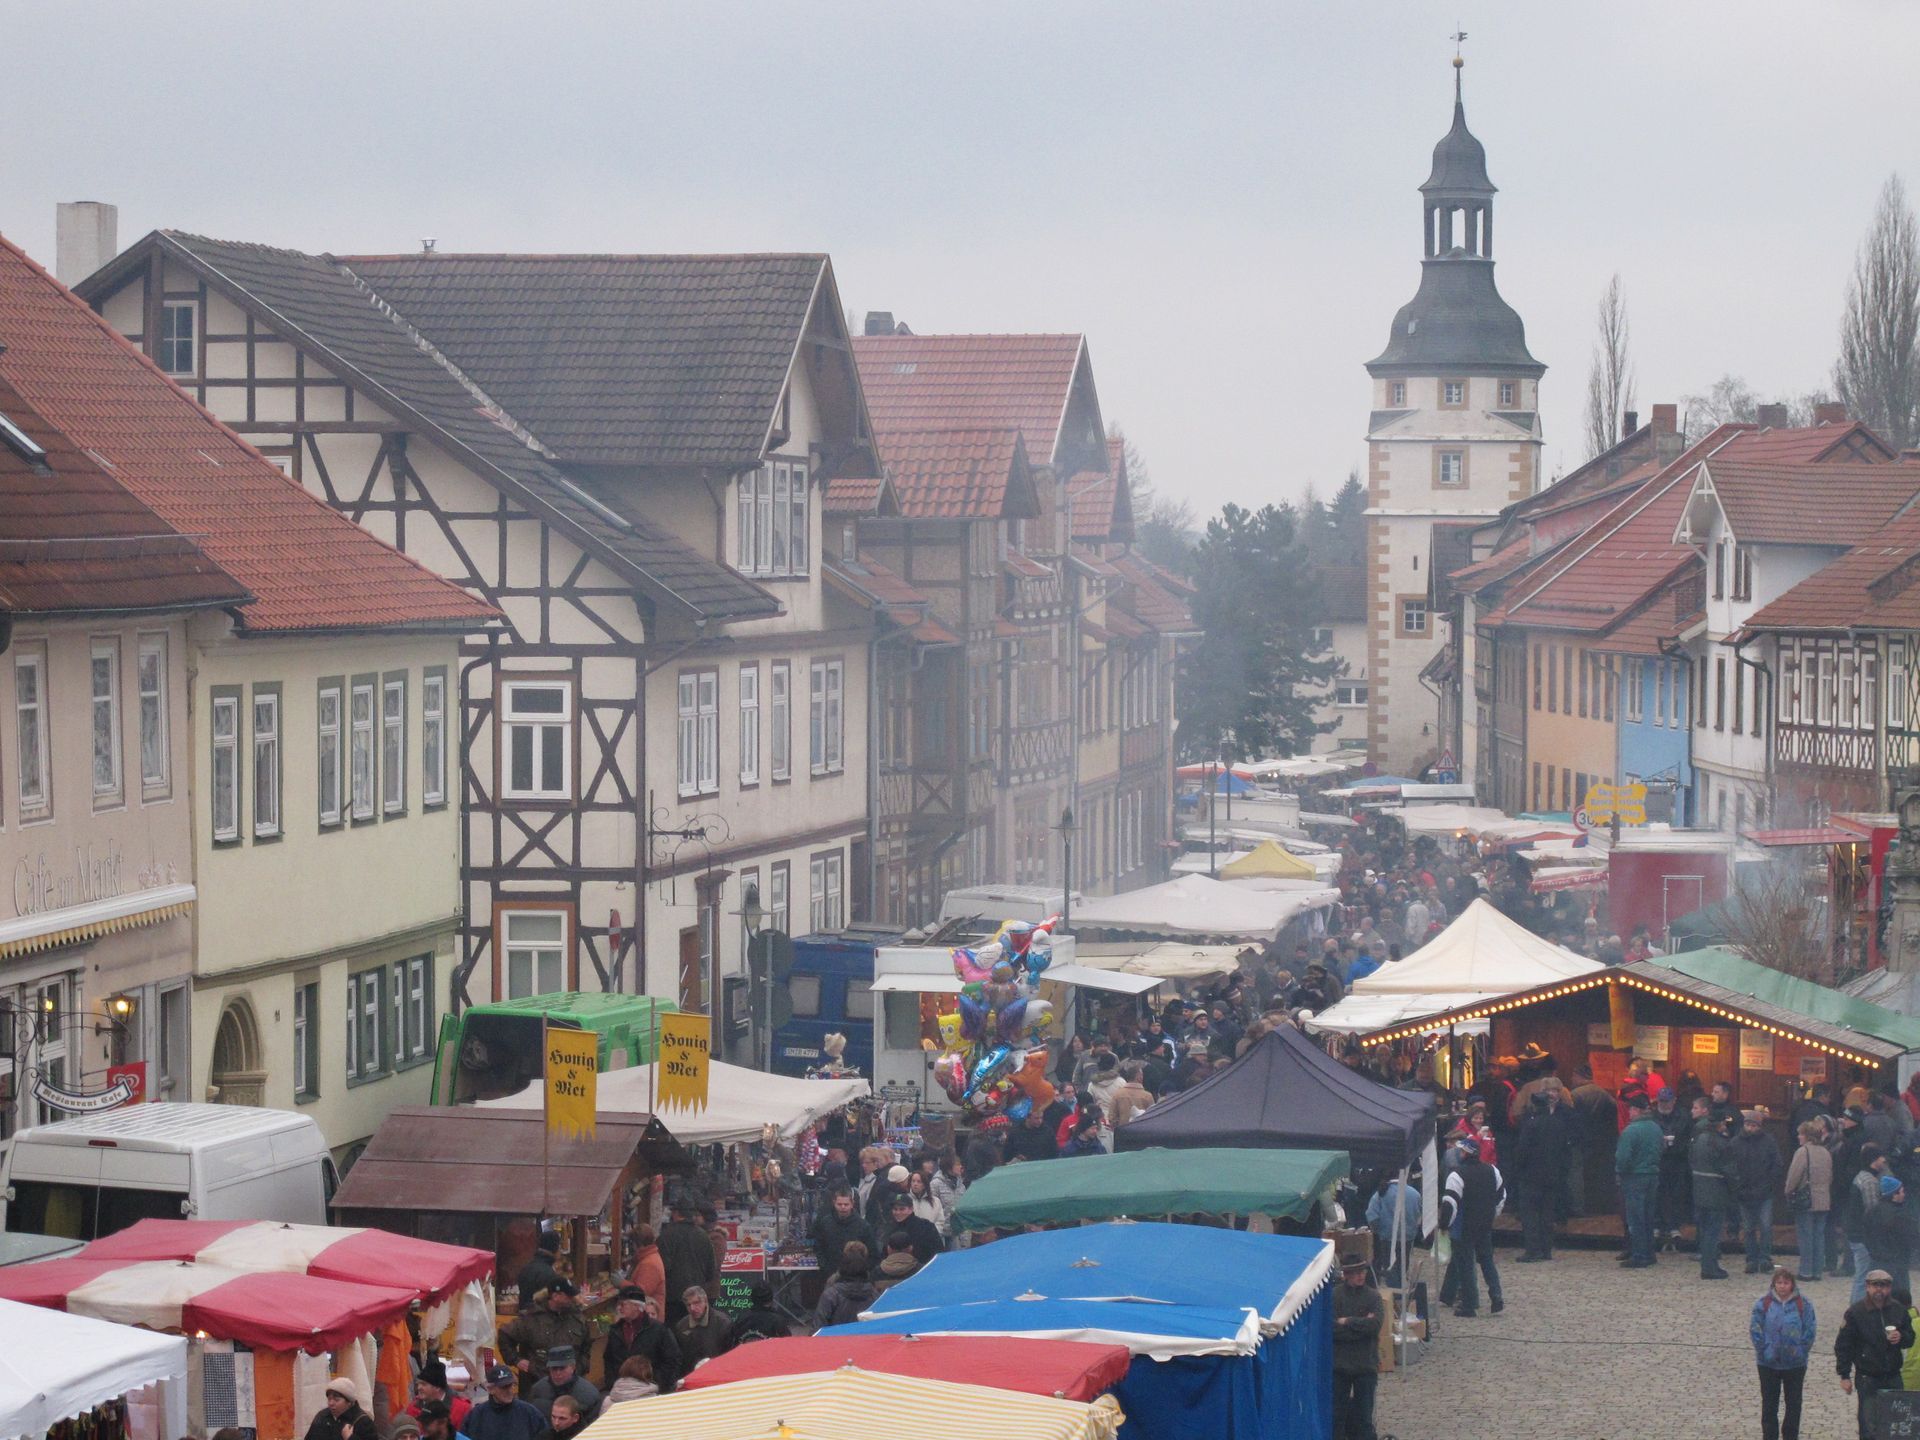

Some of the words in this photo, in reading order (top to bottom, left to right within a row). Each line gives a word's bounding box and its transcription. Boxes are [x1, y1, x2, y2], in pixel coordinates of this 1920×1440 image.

[76, 838, 125, 903] Markt
[661, 1032, 707, 1052] Honig
[549, 1048, 595, 1072] Honig
[679, 1050, 690, 1062] &
[567, 1068, 578, 1080] &
[666, 1061, 699, 1077] Met
[42, 1088, 97, 1107] Restaurant
[555, 1080, 587, 1097] Met
